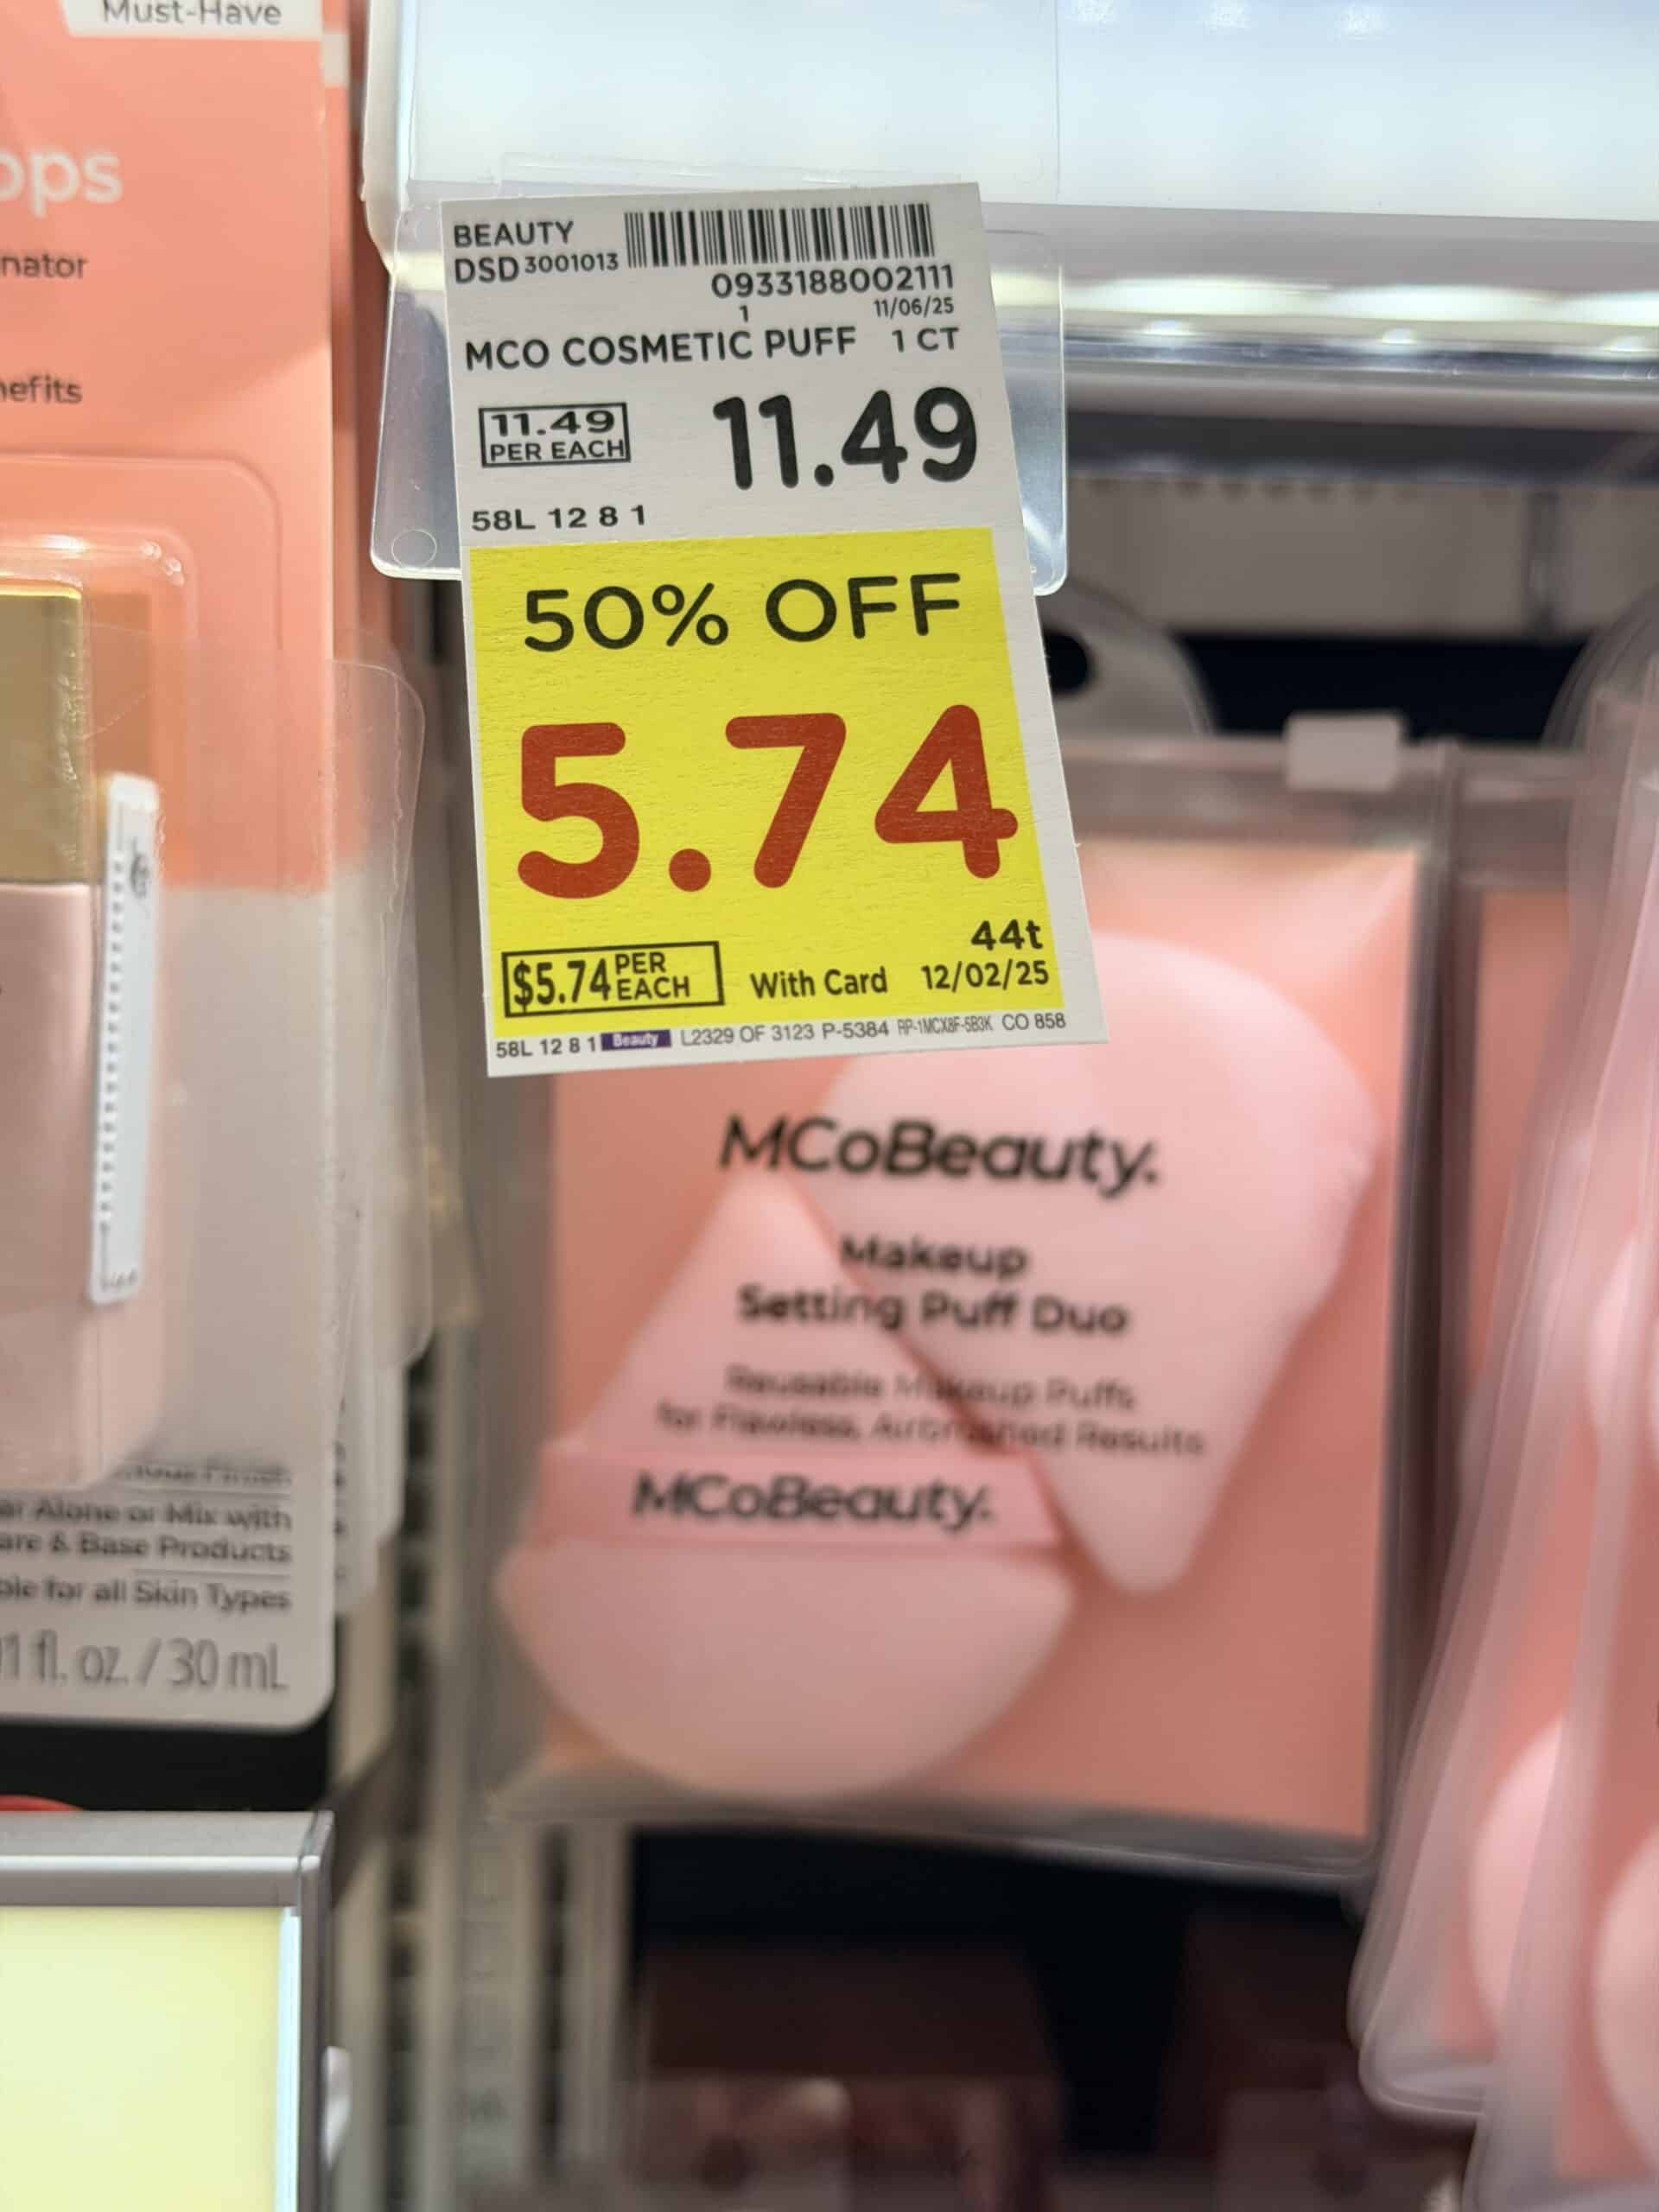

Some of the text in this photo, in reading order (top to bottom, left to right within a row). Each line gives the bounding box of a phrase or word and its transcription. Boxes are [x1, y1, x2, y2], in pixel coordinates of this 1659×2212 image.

[102, 0, 282, 25] Must-Have
[454, 220, 575, 248] BEAUTY
[0, 253, 88, 279] nator
[711, 264, 954, 299] 0933188002111
[739, 296, 955, 322] 1 11/06/25
[465, 326, 960, 372] MCO COSMETIC PUFF 1 CT
[489, 409, 616, 437] 11.49
[713, 385, 978, 491] 11.49
[488, 438, 626, 463] PER EACH
[471, 505, 646, 531] 58L 12 8 1
[524, 572, 961, 652] 50% OFF
[517, 704, 1019, 899] 5.74
[970, 918, 1044, 951] 44t
[614, 951, 666, 976] PER
[920, 957, 1050, 993] 12/02/25
[512, 959, 612, 1012] $5.74
[616, 975, 691, 1001] EACH
[750, 965, 888, 999] With Card
[680, 1021, 890, 1047] L2329 OF 3123 P-5384
[1001, 1011, 1067, 1032] CO 858
[495, 1036, 596, 1058] 58L 12 8 1
[612, 1032, 660, 1048] Beauty
[839, 1234, 1028, 1281] Makeup
[736, 1284, 1130, 1336] Setting Puff Duo
[79, 1531, 149, 1556] Base
[159, 1535, 293, 1563] Products
[94, 1579, 127, 1604] all
[134, 1580, 200, 1605] Skin
[207, 1583, 292, 1615] Types
[170, 1637, 219, 1688] 30
[227, 1643, 289, 1691] mL
